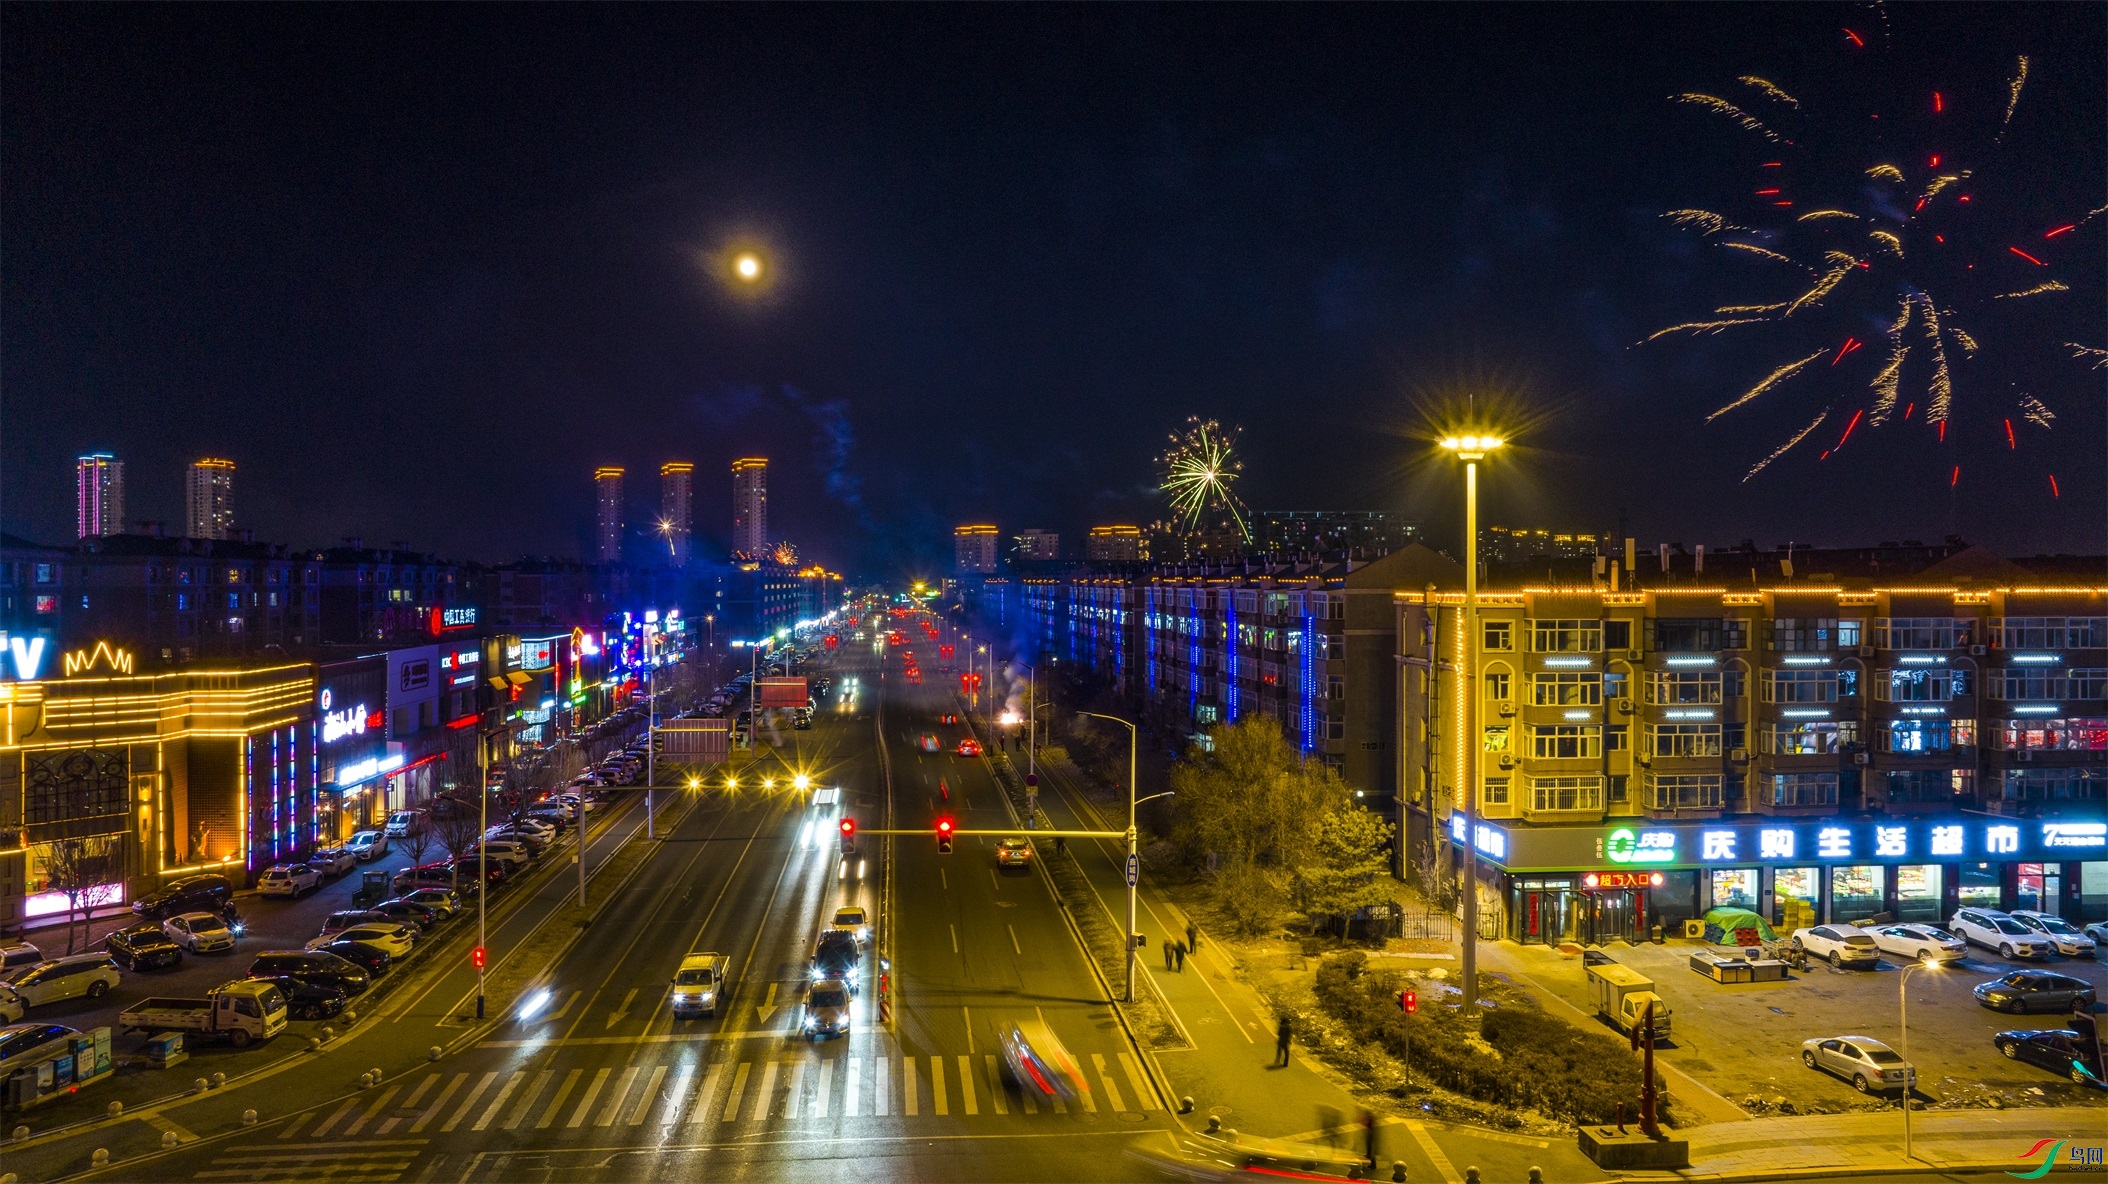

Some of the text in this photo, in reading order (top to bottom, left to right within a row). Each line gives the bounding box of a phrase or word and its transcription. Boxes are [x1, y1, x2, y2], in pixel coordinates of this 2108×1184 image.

[443, 608, 476, 626] 中国工商银行
[1453, 816, 1504, 857] 庆超市
[1702, 825, 2018, 859] 庆购生活超市
[1600, 873, 1649, 887] 超市入口
